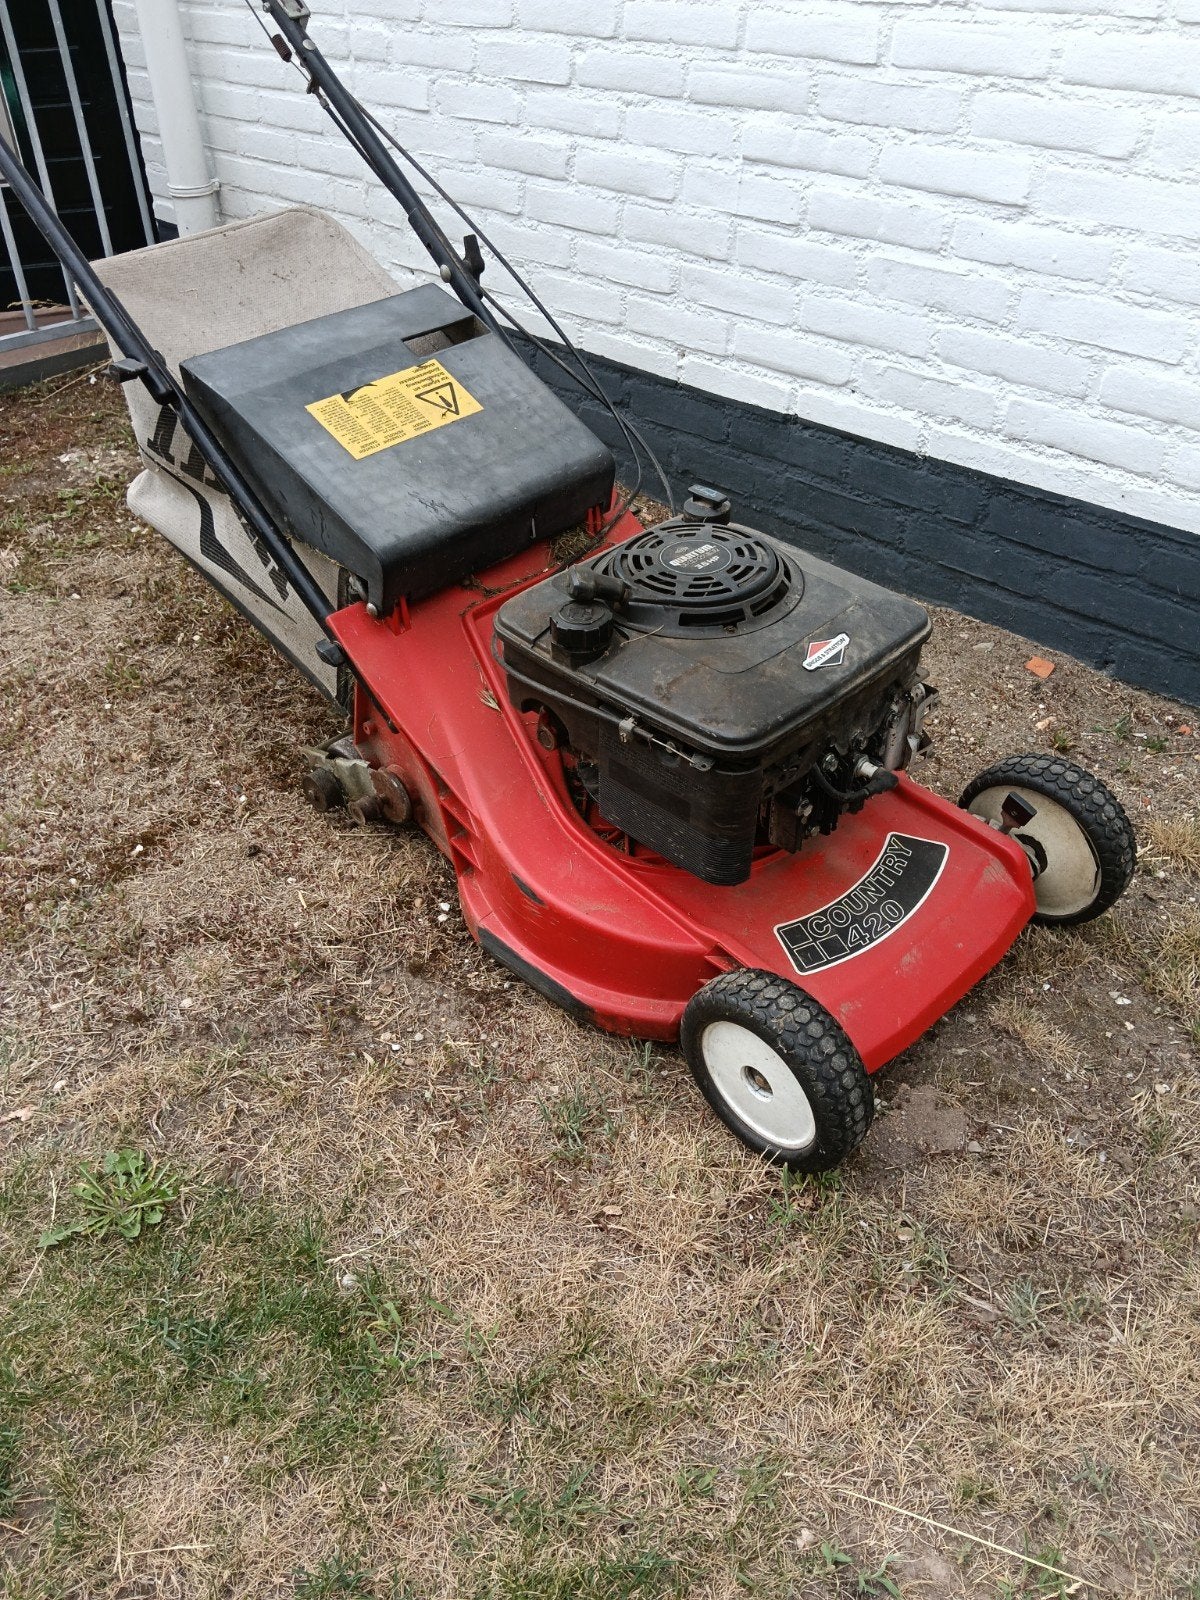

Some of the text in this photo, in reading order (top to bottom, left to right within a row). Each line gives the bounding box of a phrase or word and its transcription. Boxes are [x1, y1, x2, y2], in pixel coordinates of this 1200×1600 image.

[824, 637, 846, 655] STRATTON
[807, 837, 913, 938] COUNTRY
[847, 899, 905, 949] 420
